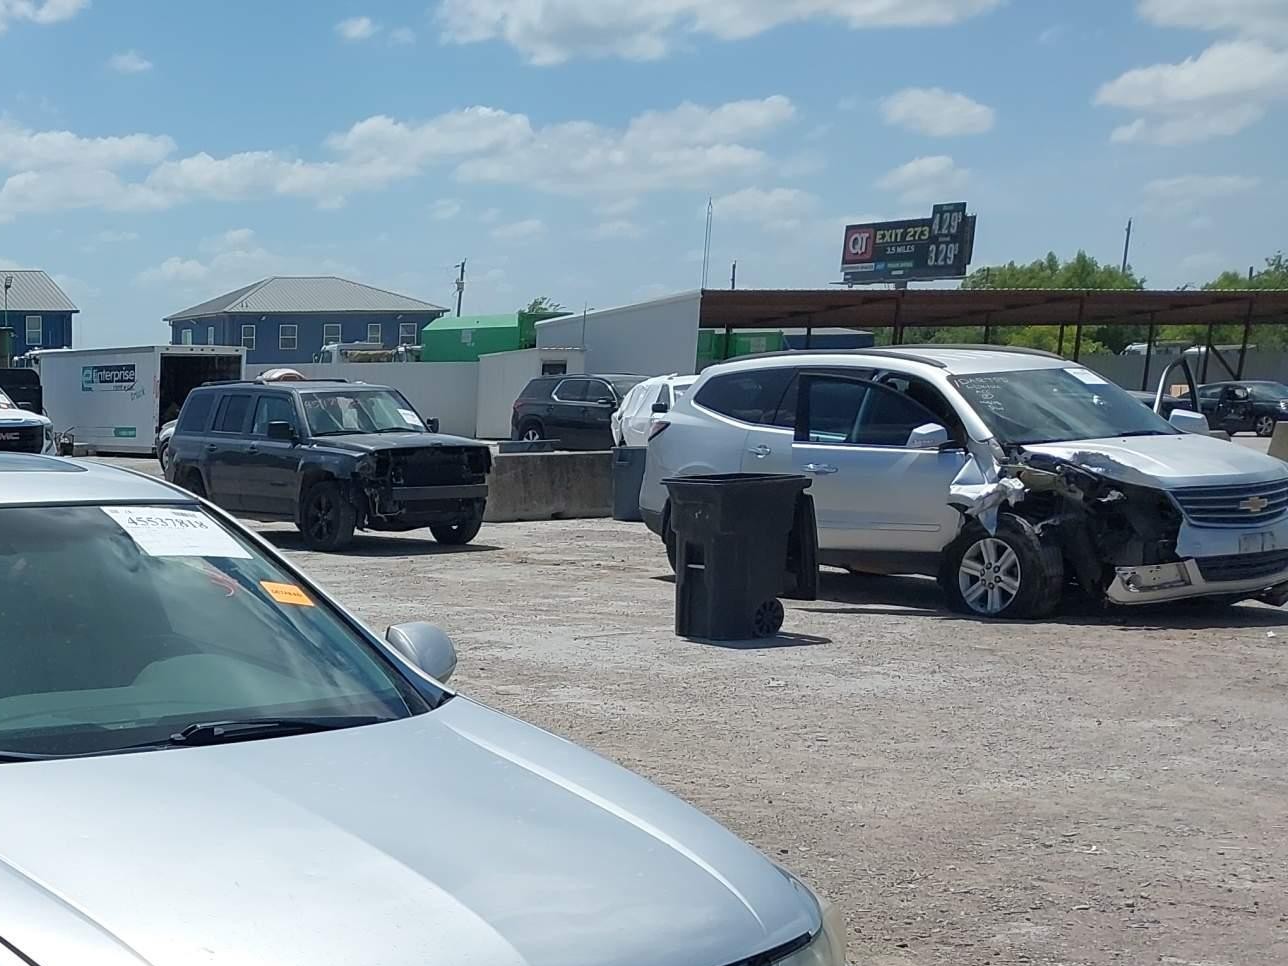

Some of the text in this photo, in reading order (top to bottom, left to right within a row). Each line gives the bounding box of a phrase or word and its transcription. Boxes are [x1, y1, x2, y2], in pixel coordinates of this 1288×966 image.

[875, 229, 904, 243] EXIT
[905, 226, 930, 241] 273
[848, 232, 870, 255] QT
[93, 366, 135, 384] Enterprise
[127, 515, 210, 530] 45537818
